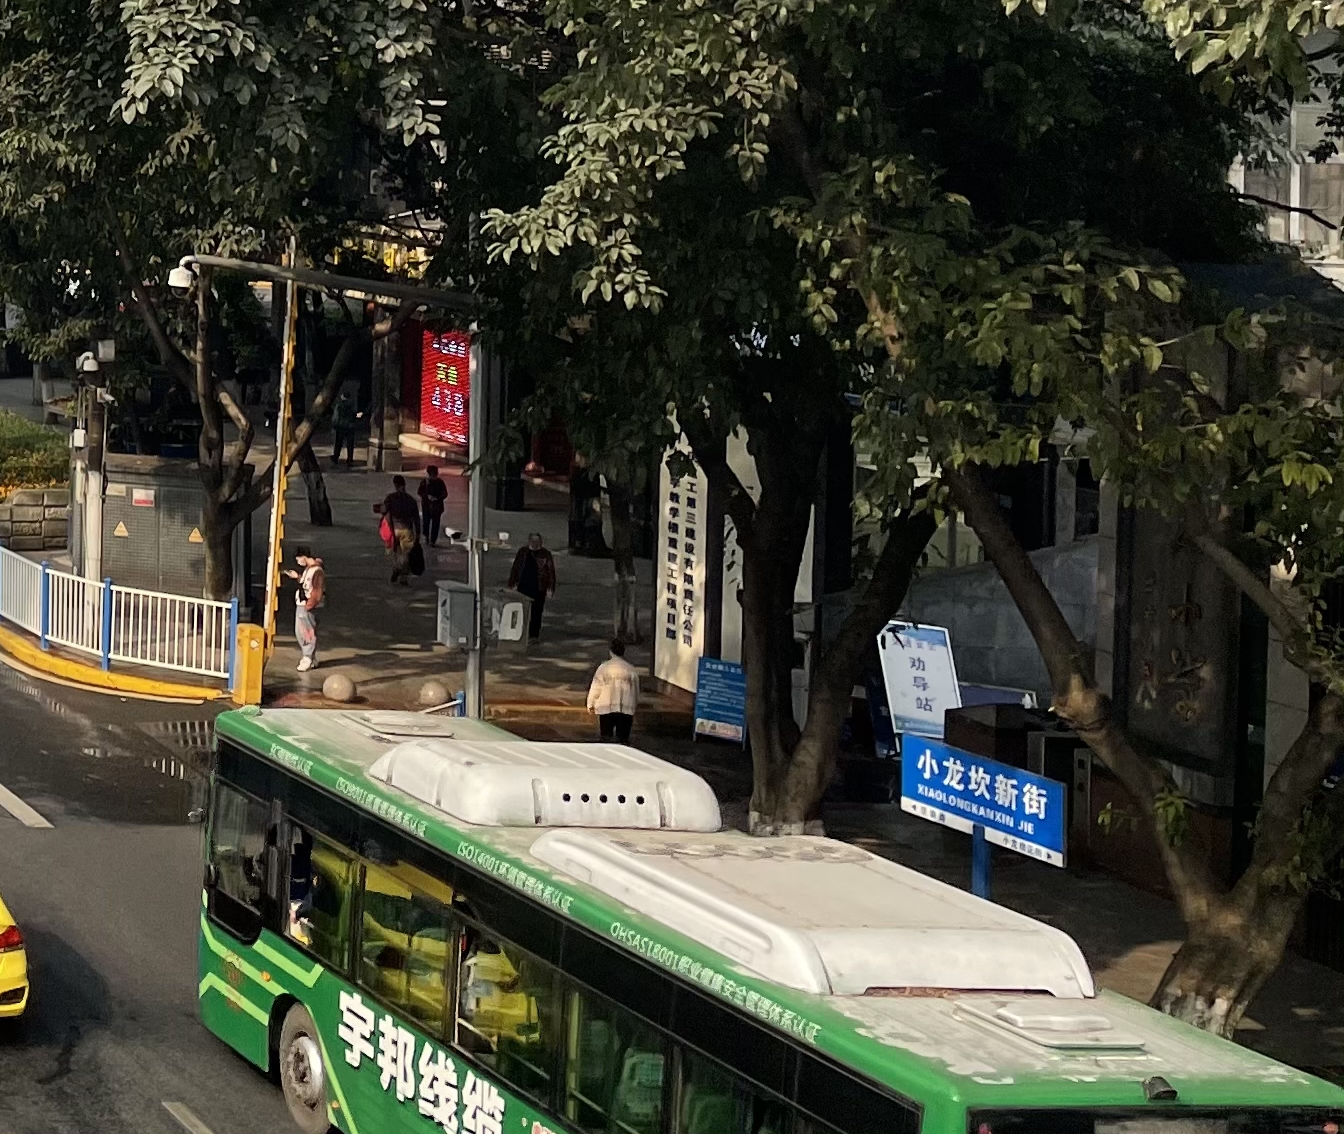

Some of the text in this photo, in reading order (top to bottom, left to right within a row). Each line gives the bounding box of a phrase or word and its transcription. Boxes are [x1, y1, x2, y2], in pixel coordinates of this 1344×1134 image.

[909, 656, 937, 712] 劝导站
[917, 749, 1048, 819] 小龙坎新街
[917, 783, 1015, 828] XIAOLONGKANXIN
[1017, 820, 1035, 836] JIE
[338, 990, 505, 1134] 宇邦线缆
